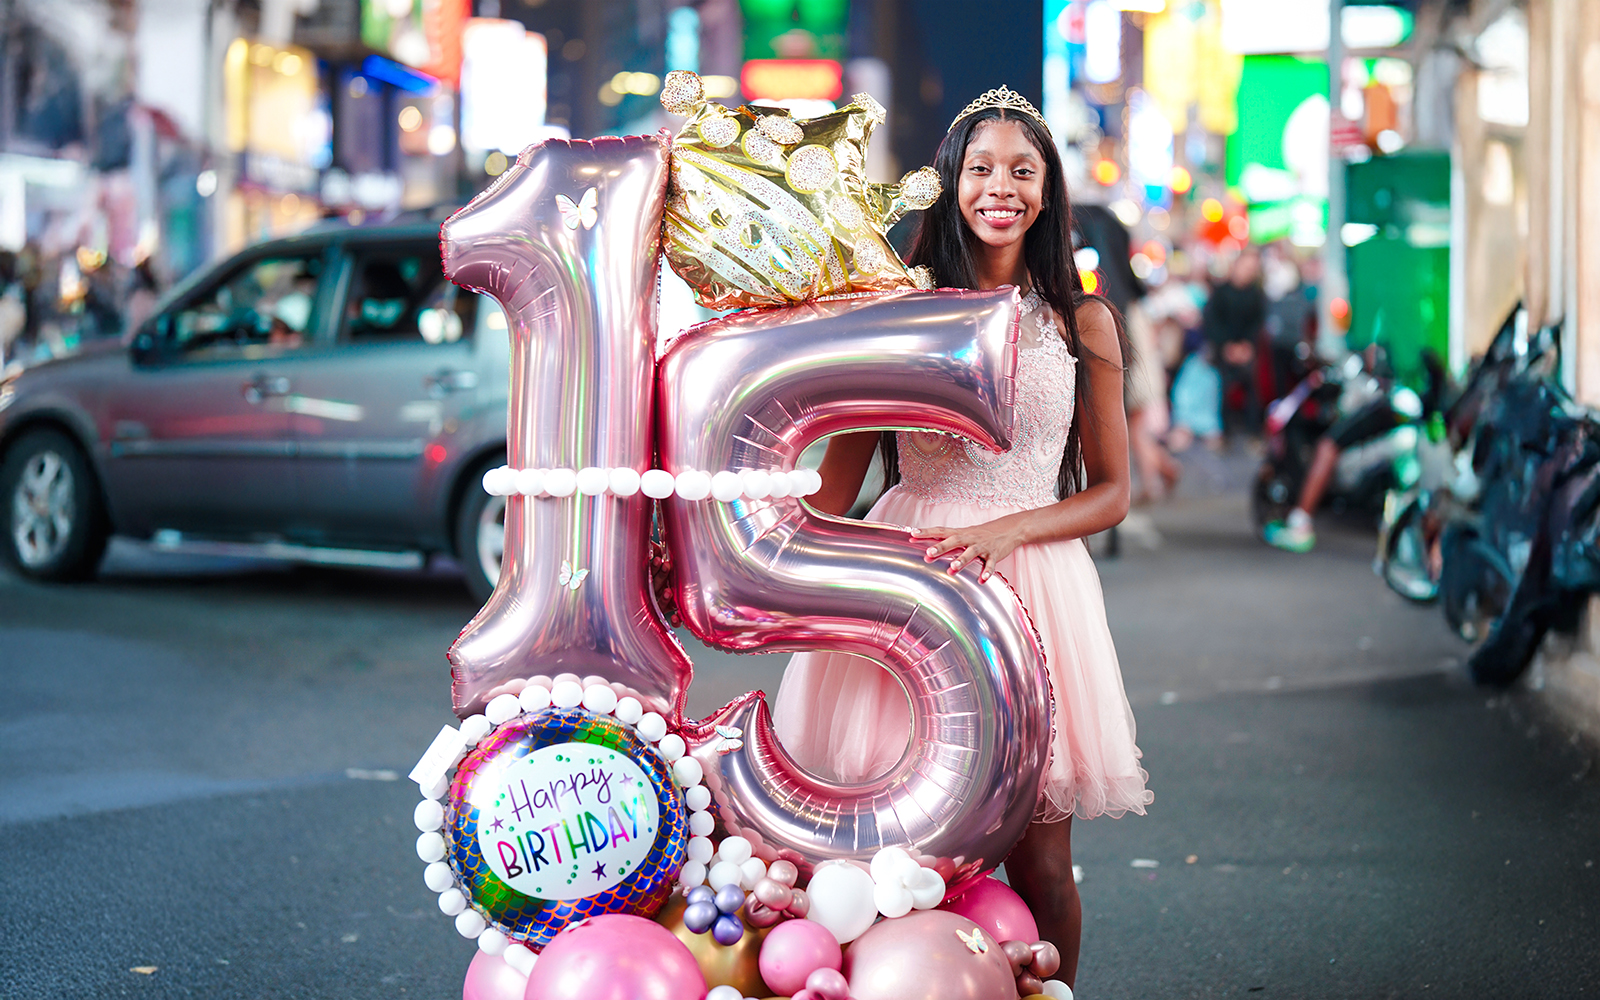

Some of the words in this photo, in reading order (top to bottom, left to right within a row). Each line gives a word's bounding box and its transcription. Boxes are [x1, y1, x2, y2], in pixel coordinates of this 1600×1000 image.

[440, 131, 1055, 889] 15
[497, 793, 652, 879] BIRTHDAY!
[507, 768, 613, 822] Happy
